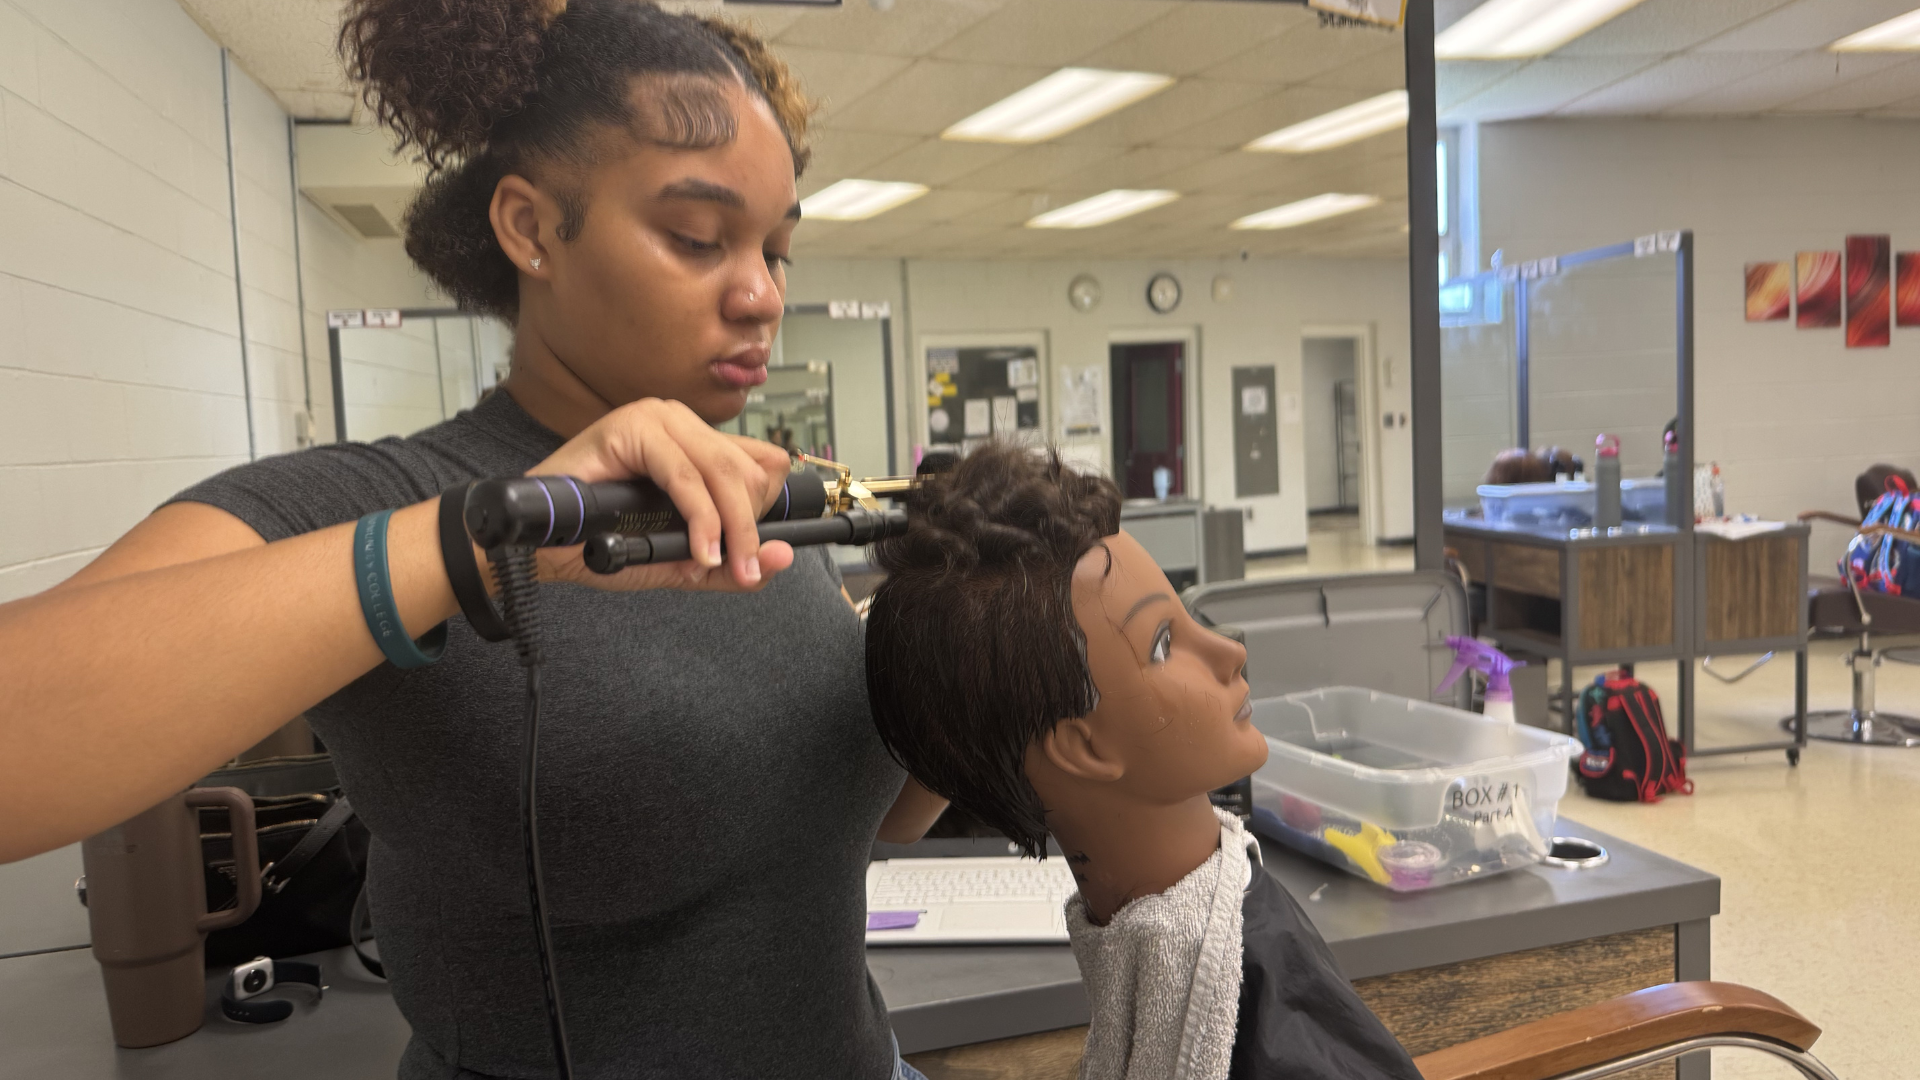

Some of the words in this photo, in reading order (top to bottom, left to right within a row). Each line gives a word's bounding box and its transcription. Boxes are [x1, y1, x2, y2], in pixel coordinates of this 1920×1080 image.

[366, 571, 393, 637] COLLEGE
[1452, 785, 1492, 810] BOX
[1497, 782, 1508, 802] #
[1473, 809, 1501, 825] Part
[1504, 804, 1513, 818] A
